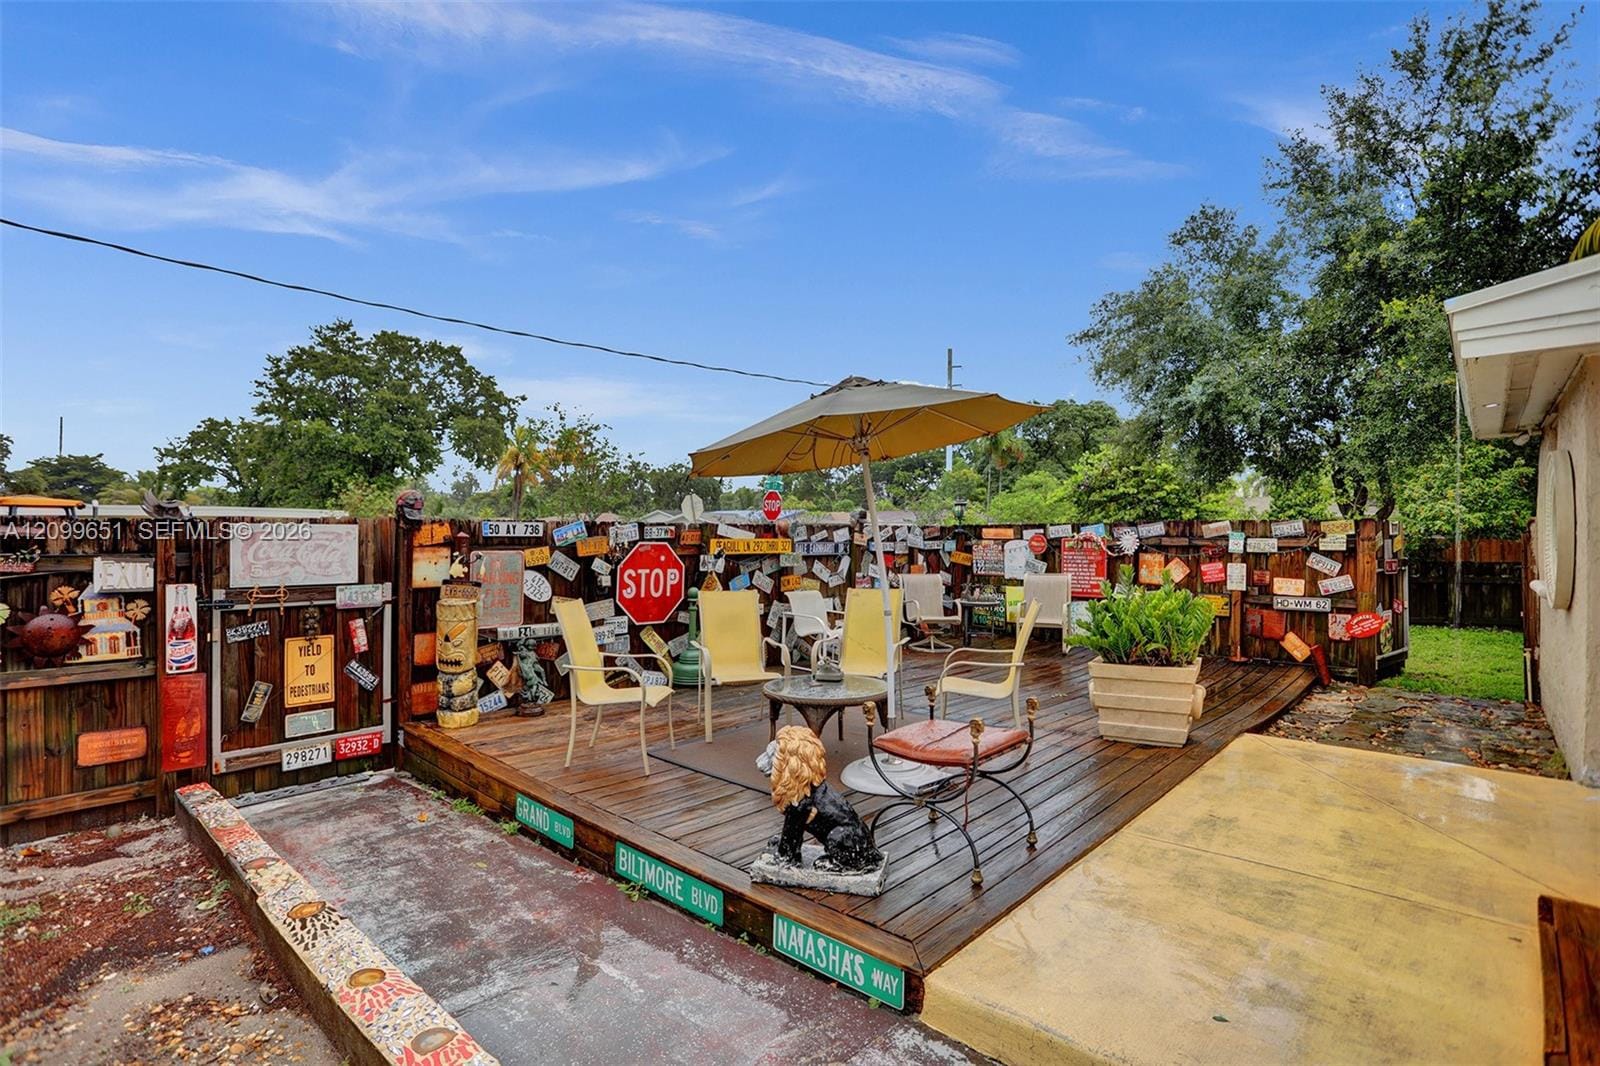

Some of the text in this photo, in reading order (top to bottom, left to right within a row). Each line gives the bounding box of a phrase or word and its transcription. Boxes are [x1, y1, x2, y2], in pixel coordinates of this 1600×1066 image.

[764, 500, 781, 511] STOP
[489, 525, 540, 535] 50 AY 736
[780, 540, 791, 551] 327
[622, 568, 680, 599] STOP
[298, 644, 322, 657] YIELD
[305, 664, 316, 677] TO
[289, 682, 330, 698] PEDESTRIANS
[286, 746, 328, 766] 298271
[516, 797, 571, 838] GRAND BLVD
[619, 847, 718, 915] BILTMORE BLVD
[777, 917, 899, 996] NATASHA'S WAY
